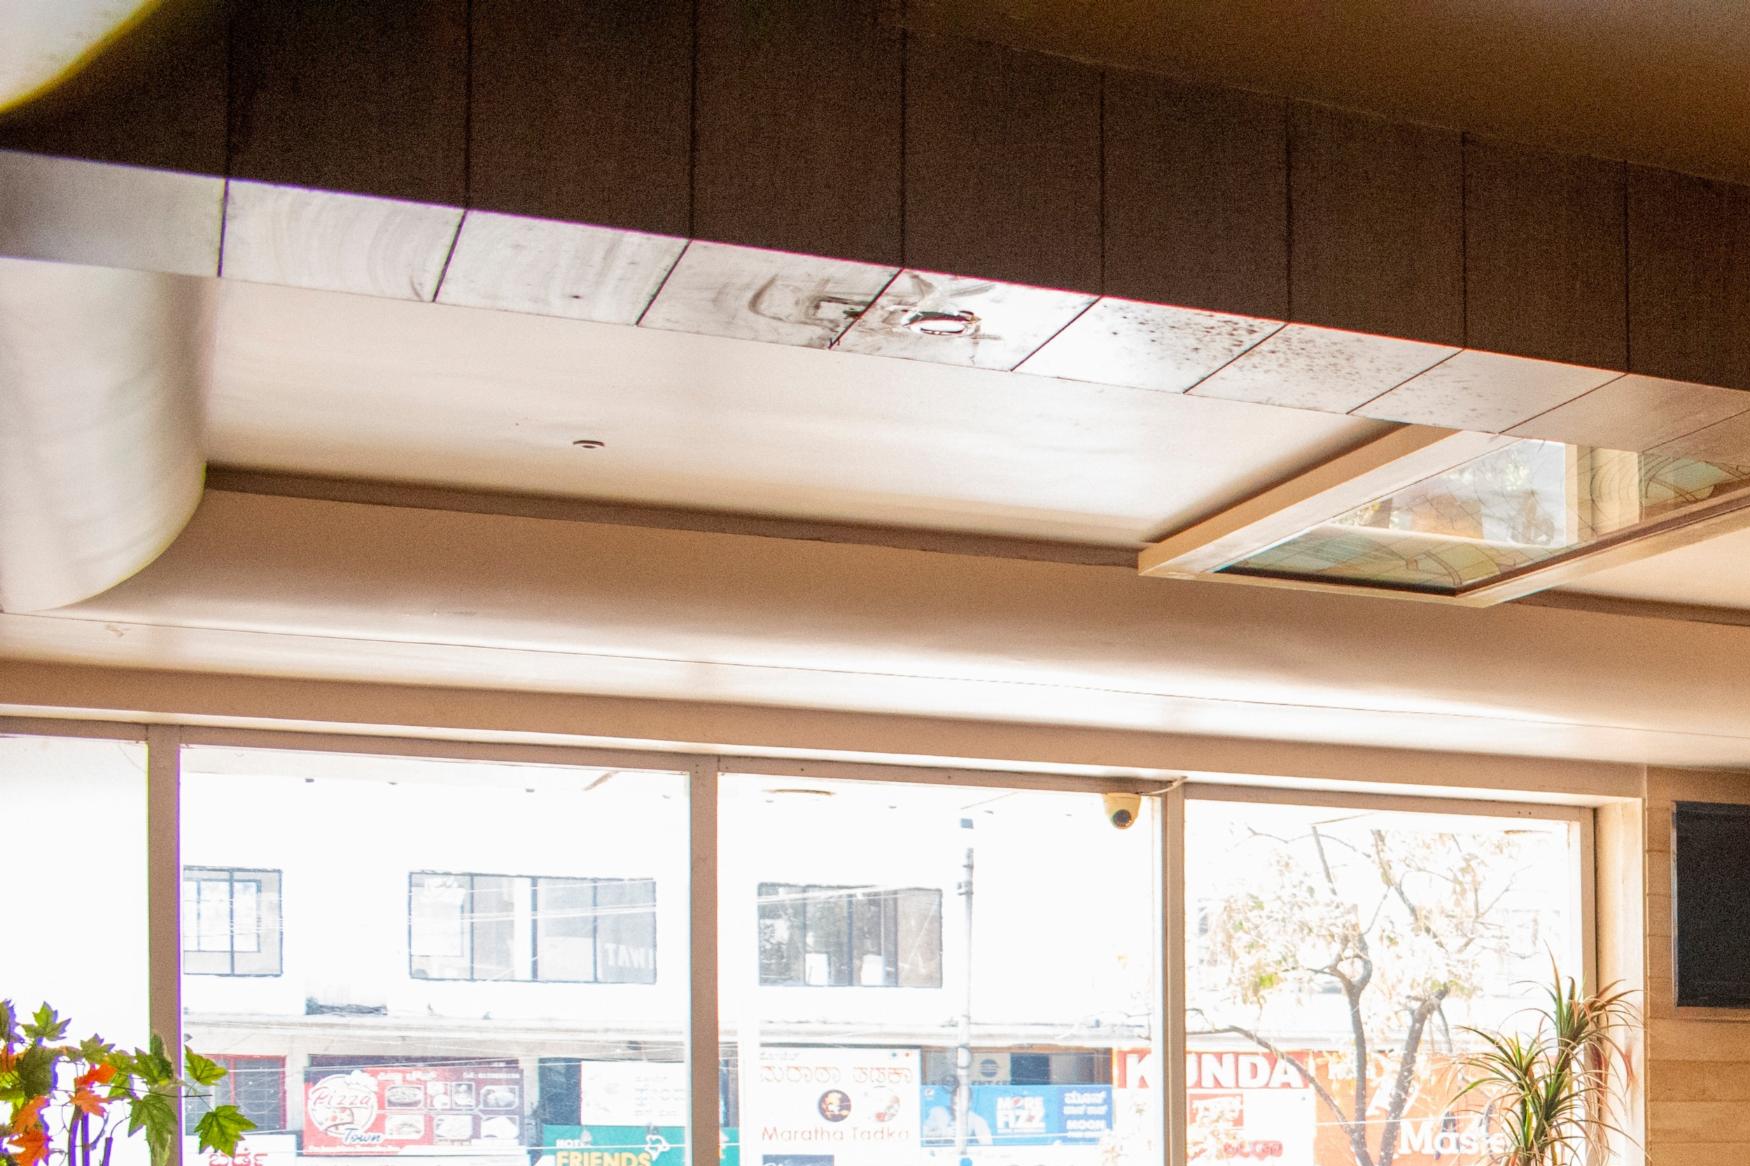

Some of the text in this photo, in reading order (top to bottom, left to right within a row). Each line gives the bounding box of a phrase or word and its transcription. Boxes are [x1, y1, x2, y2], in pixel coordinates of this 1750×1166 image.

[1126, 1053, 1304, 1088] KNDA
[313, 1089, 370, 1107] Pizza
[344, 1128, 381, 1142] Town
[762, 1127, 909, 1141] Maratha Tadka
